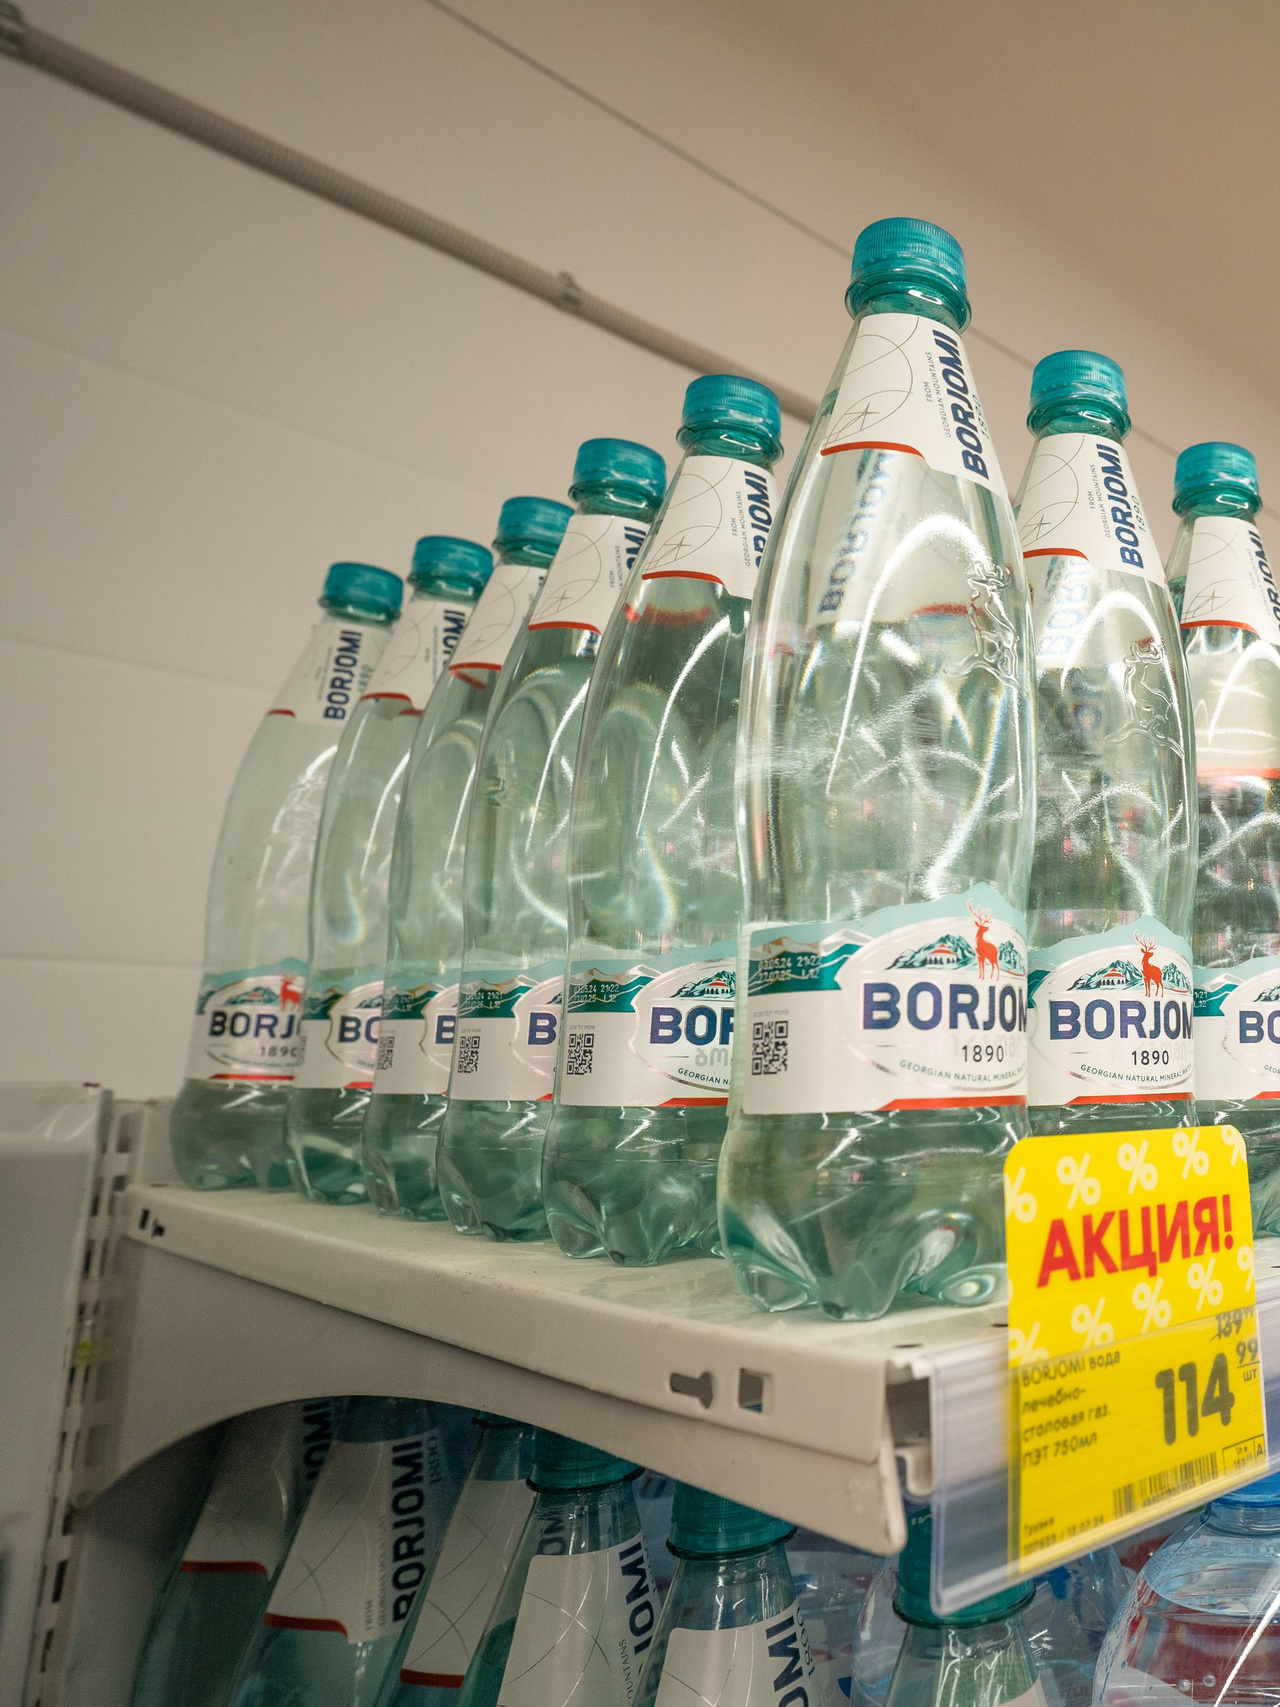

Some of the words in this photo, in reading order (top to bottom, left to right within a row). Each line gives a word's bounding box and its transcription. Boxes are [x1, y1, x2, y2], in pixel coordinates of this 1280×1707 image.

[925, 351, 940, 396] MOUNTAINS
[923, 381, 932, 402] FROM
[932, 329, 989, 480] BORJOMI
[937, 397, 951, 438] GEORGIAN
[1087, 491, 1095, 509] FROM
[1089, 464, 1103, 502] MOUNTAINS
[735, 490, 746, 531] MOUNTAINS
[1096, 443, 1144, 569] BORJOMI
[1099, 503, 1111, 538] GEORGIAN
[741, 533, 751, 567] GEORGIAN
[323, 630, 362, 720] BORJOMI
[899, 1059, 952, 1079] GEORGIAN
[953, 1072, 992, 1082] NATURAL
[961, 1045, 1004, 1063] 1890
[1131, 1050, 1170, 1066] 1890
[677, 1067, 721, 1084] GEORGIAN
[1080, 1064, 1124, 1080] GEORGIAN
[1159, 1071, 1182, 1082] MINERAL
[1036, 1194, 1234, 1289] АКЦИЯ!
[1089, 1351, 1121, 1370] вода
[1236, 1338, 1259, 1365] 99
[1155, 1352, 1235, 1446] 114
[1023, 1411, 1085, 1442] столовая
[1022, 1445, 1048, 1470] ПЭТ
[1053, 1432, 1097, 1458] 750мл
